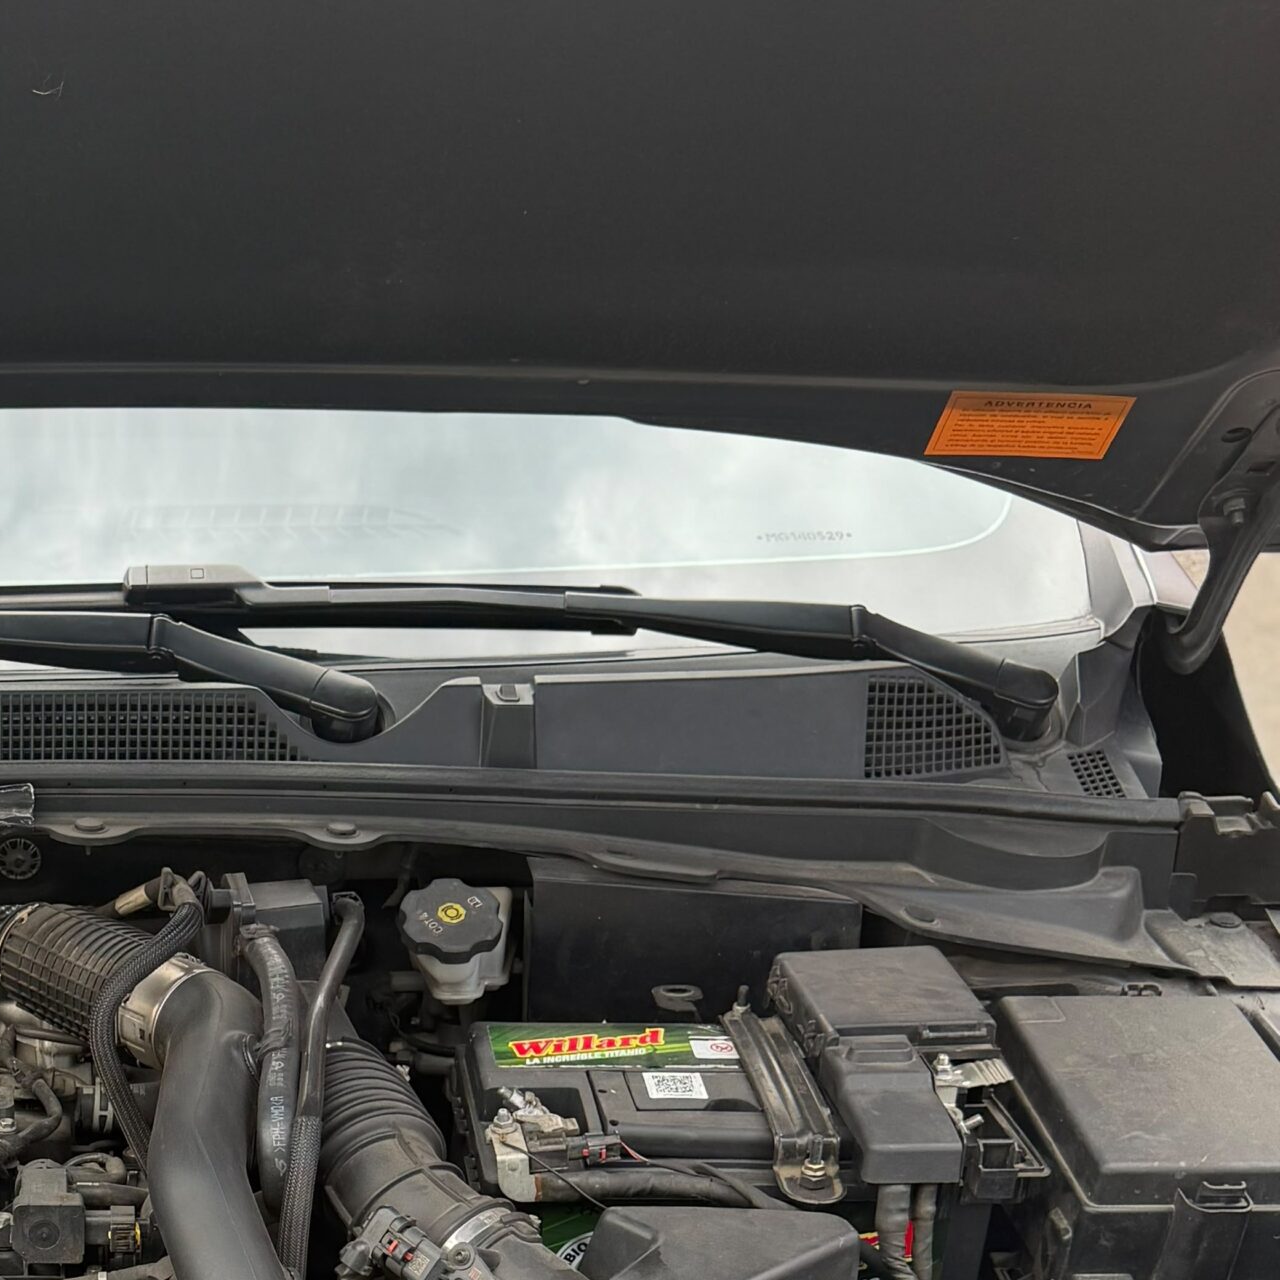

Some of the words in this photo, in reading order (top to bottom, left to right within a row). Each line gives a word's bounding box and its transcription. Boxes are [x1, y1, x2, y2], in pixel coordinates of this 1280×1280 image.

[984, 401, 1093, 409] ADVERTENCIA
[508, 1028, 665, 1058] Willard
[604, 1048, 647, 1058] TITANIO
